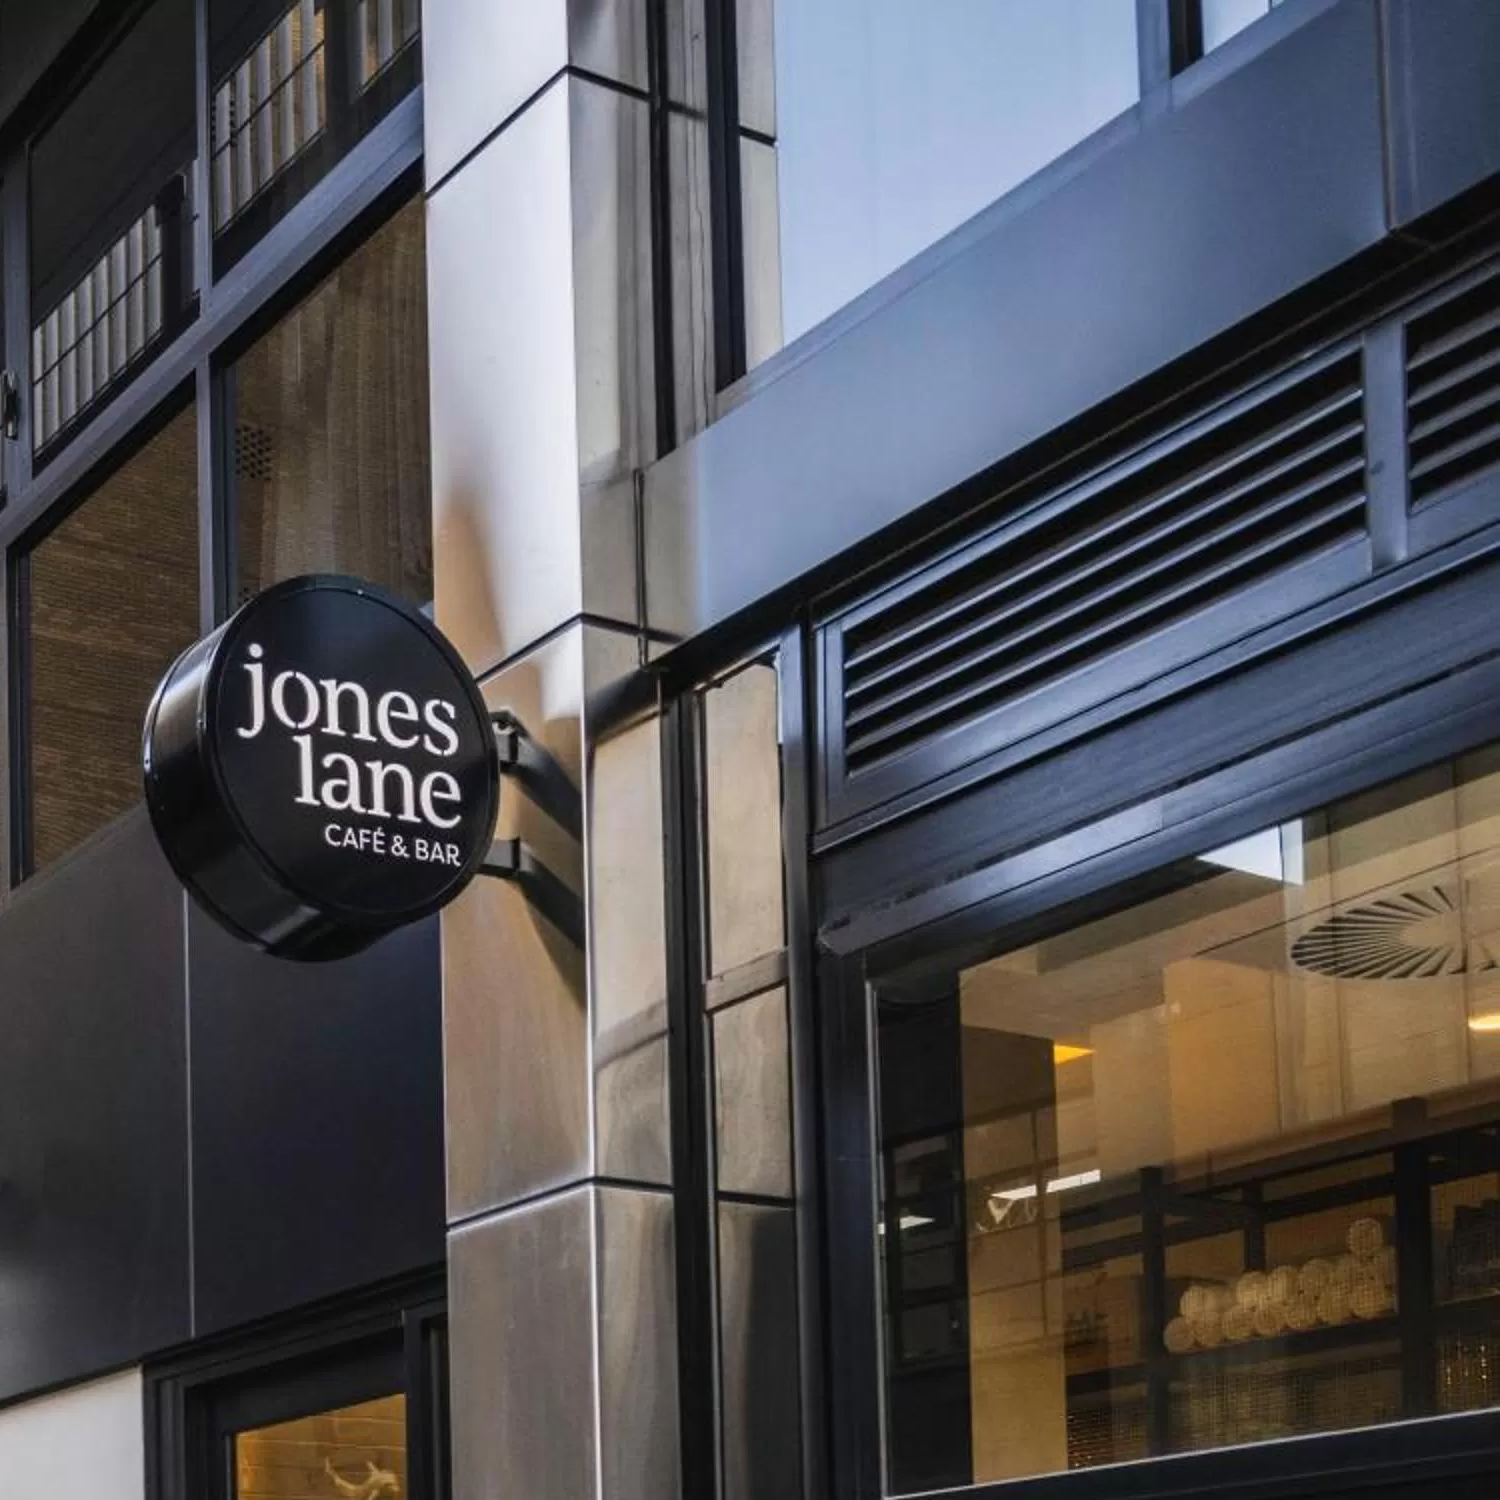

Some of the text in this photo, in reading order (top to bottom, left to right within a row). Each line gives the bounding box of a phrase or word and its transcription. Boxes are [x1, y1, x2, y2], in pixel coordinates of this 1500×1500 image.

[237, 643, 460, 756] jones
[293, 734, 462, 829] lane
[324, 823, 462, 867] CAFÉ & BAR
